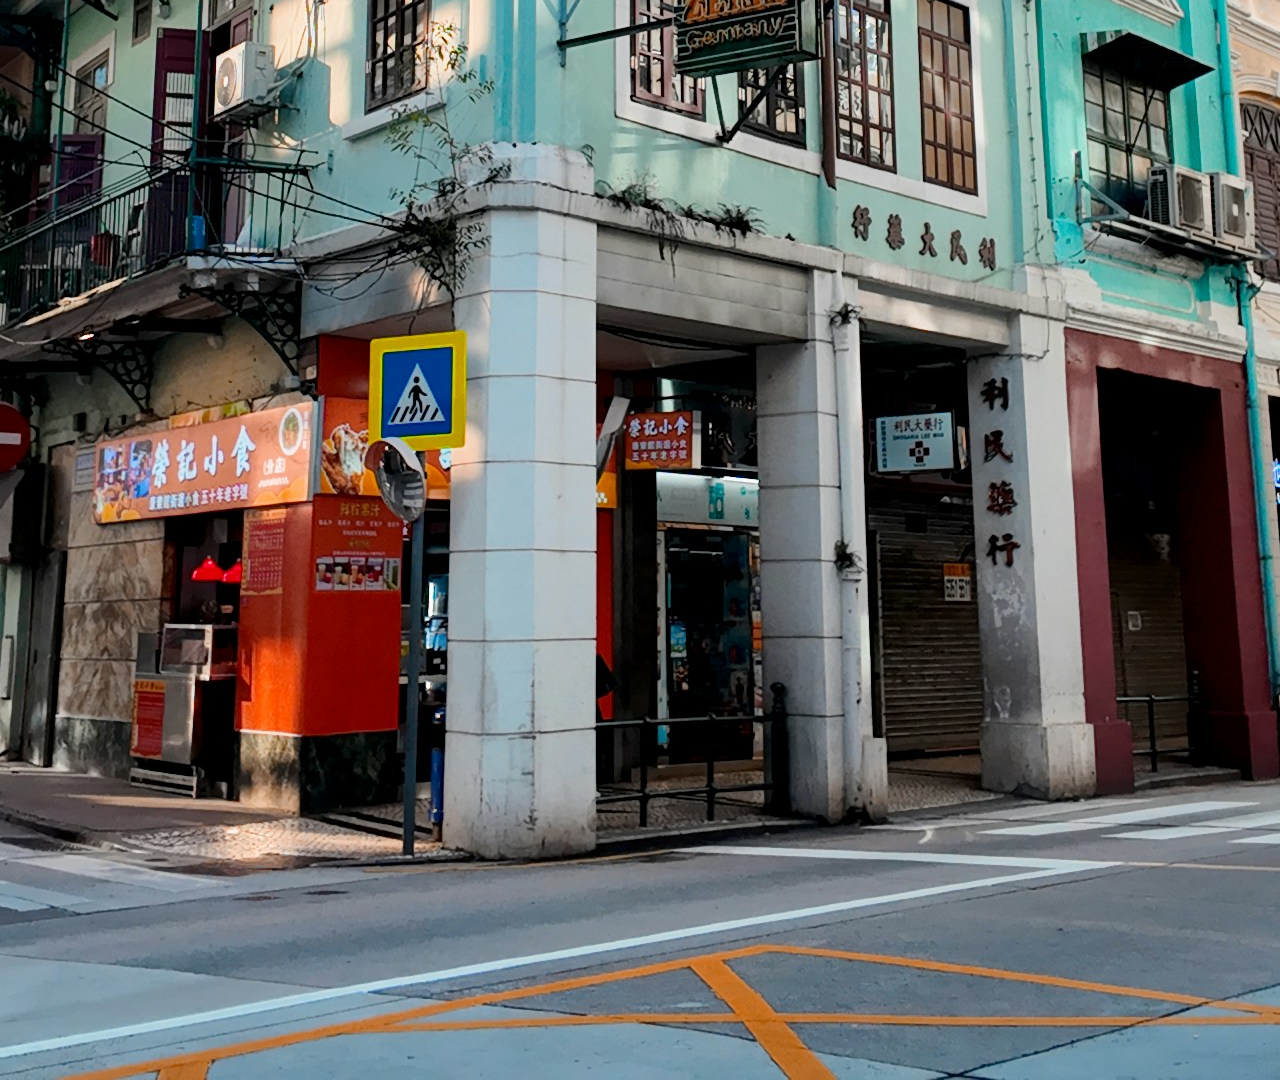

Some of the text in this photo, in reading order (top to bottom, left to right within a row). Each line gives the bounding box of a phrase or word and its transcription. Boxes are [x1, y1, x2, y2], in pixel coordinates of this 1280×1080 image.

[687, 16, 786, 49] Germany
[628, 415, 689, 438] 榮記小食
[151, 424, 257, 489] 榮記小食
[979, 376, 1022, 570] 利民藥行
